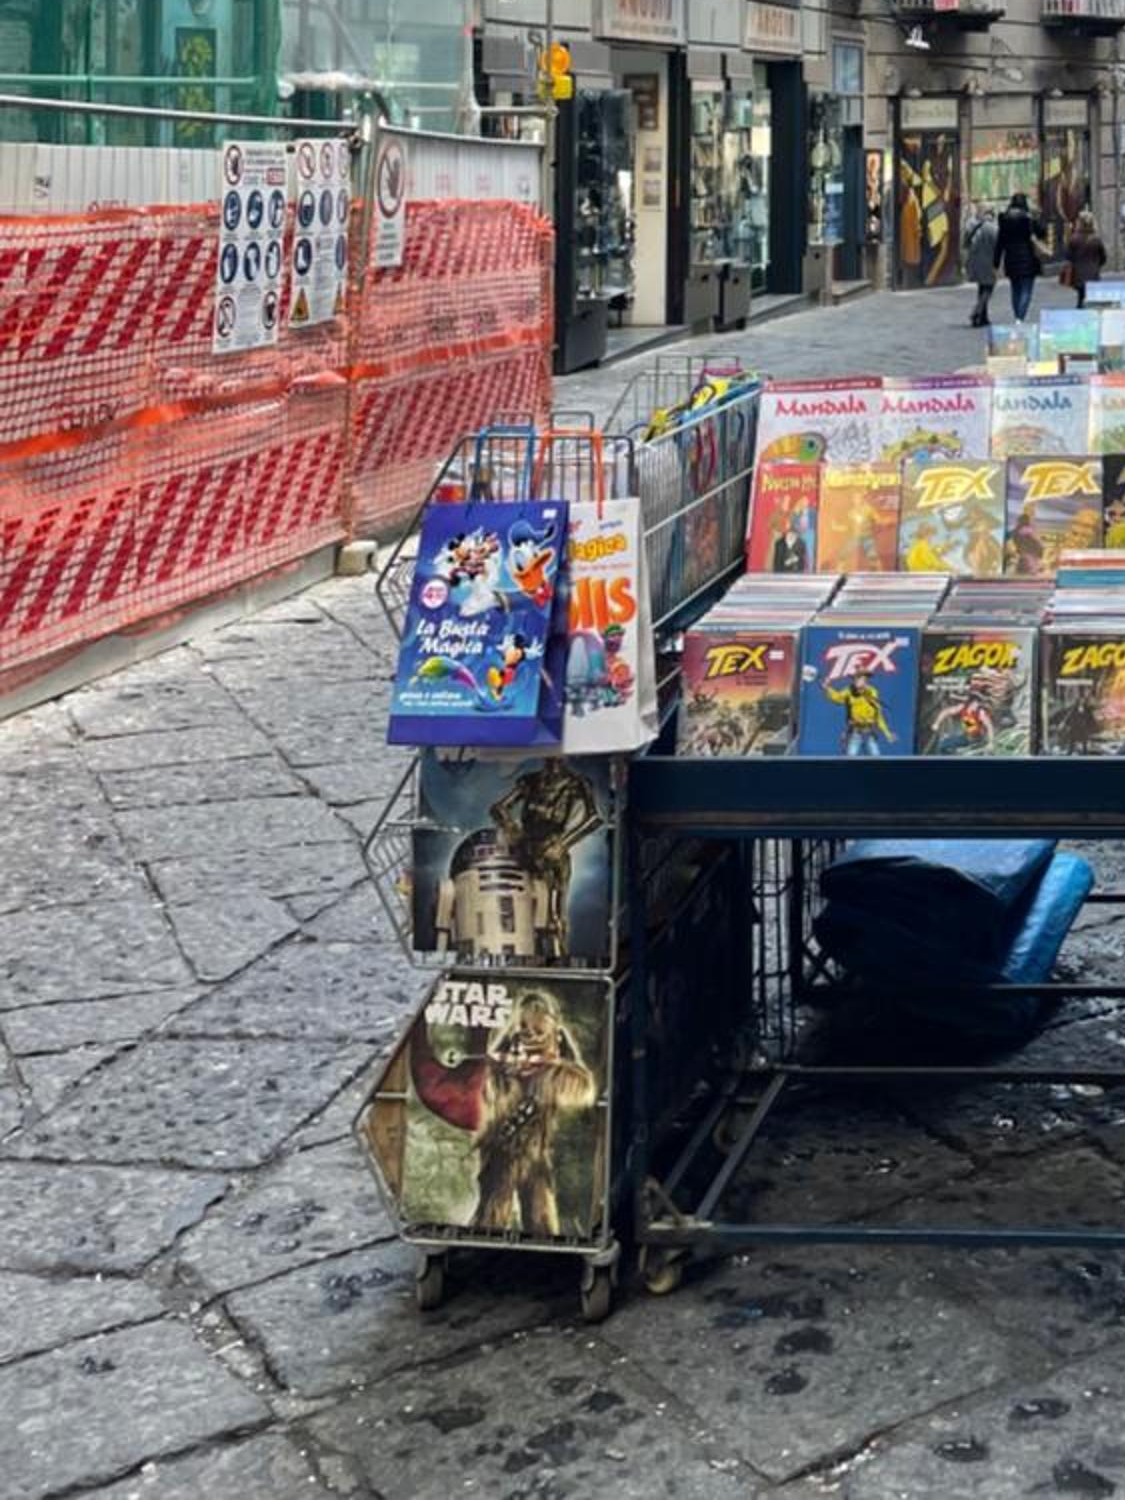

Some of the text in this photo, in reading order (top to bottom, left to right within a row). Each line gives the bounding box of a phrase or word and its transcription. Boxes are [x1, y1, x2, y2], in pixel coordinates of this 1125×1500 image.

[775, 397, 868, 418] Mandala
[879, 393, 976, 414] Mandala
[913, 465, 999, 508] TEX
[1021, 460, 1101, 500] TEX
[416, 619, 436, 636] La
[704, 643, 771, 680] TEX
[826, 639, 898, 679] TEX
[931, 642, 1022, 675] ZAGOR
[431, 981, 513, 1005] STAR
[424, 1003, 513, 1028] WARS
